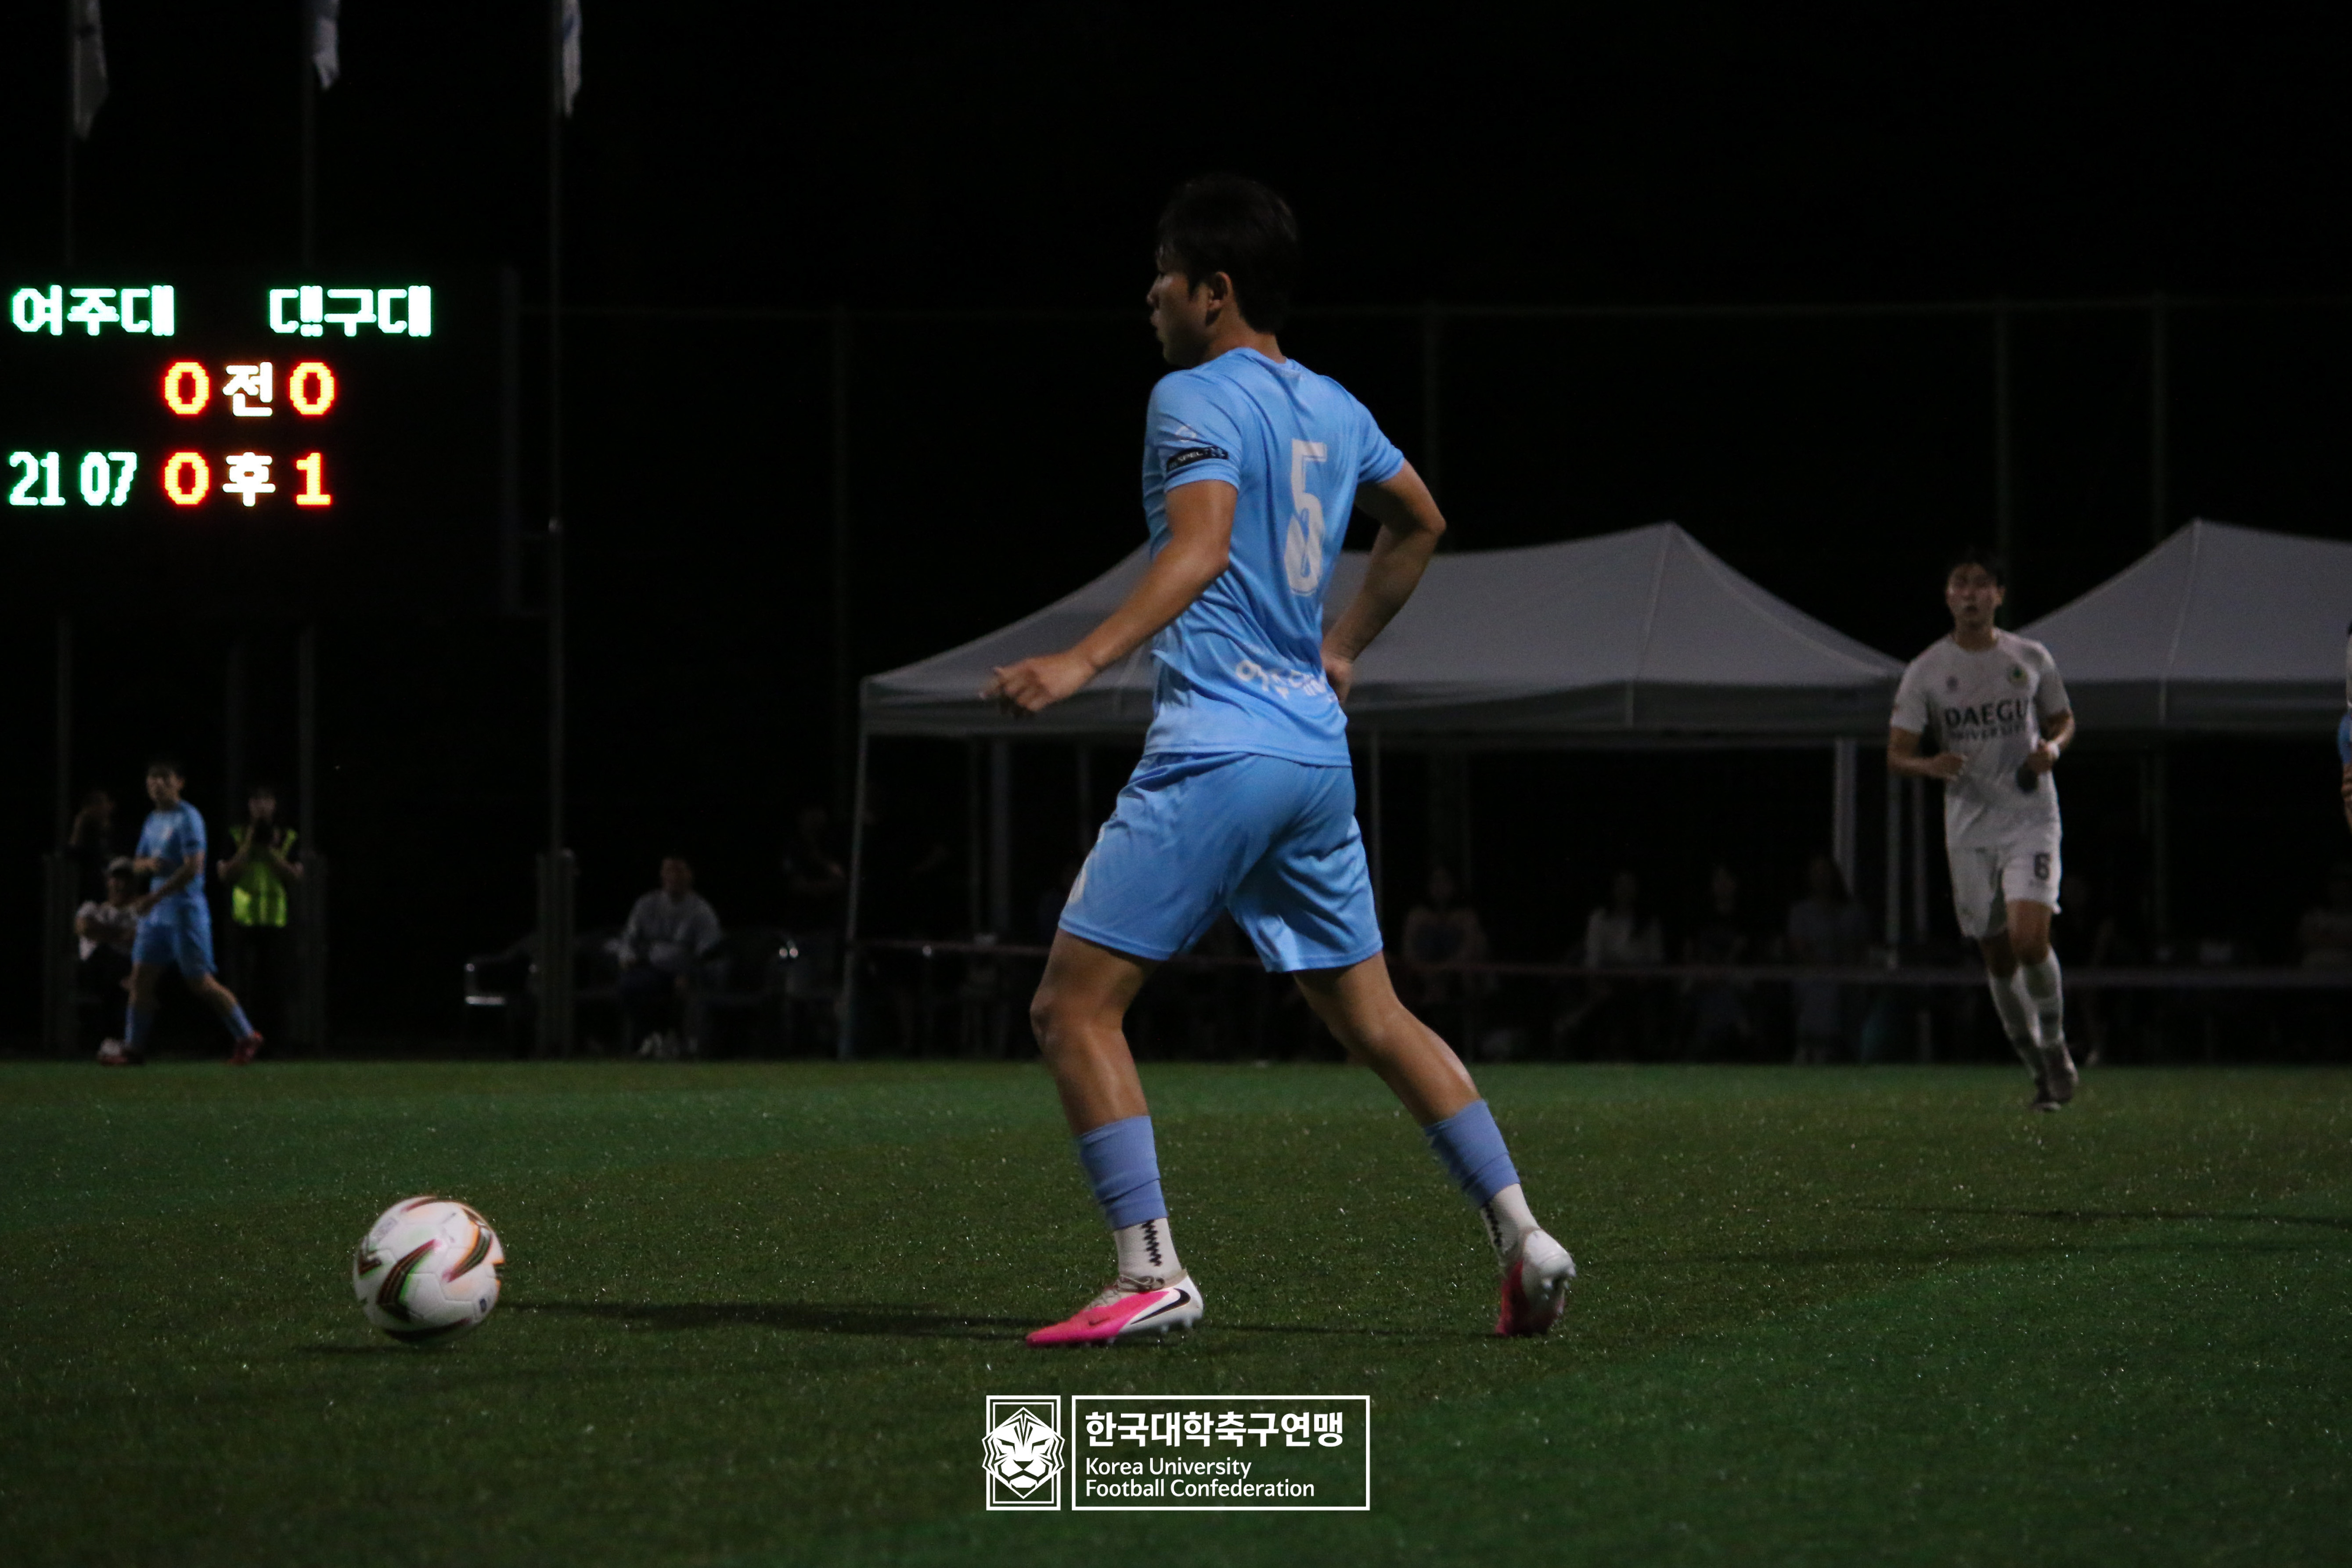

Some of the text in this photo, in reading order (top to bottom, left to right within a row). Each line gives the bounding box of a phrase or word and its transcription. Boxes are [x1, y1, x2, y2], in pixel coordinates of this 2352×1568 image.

[11, 285, 175, 337] 여주대
[163, 361, 336, 417] 0 전 0
[9, 451, 137, 506] 21 07
[163, 451, 333, 507] 0 후 1
[1284, 438, 1327, 596] 5
[2034, 853, 2050, 880] 6
